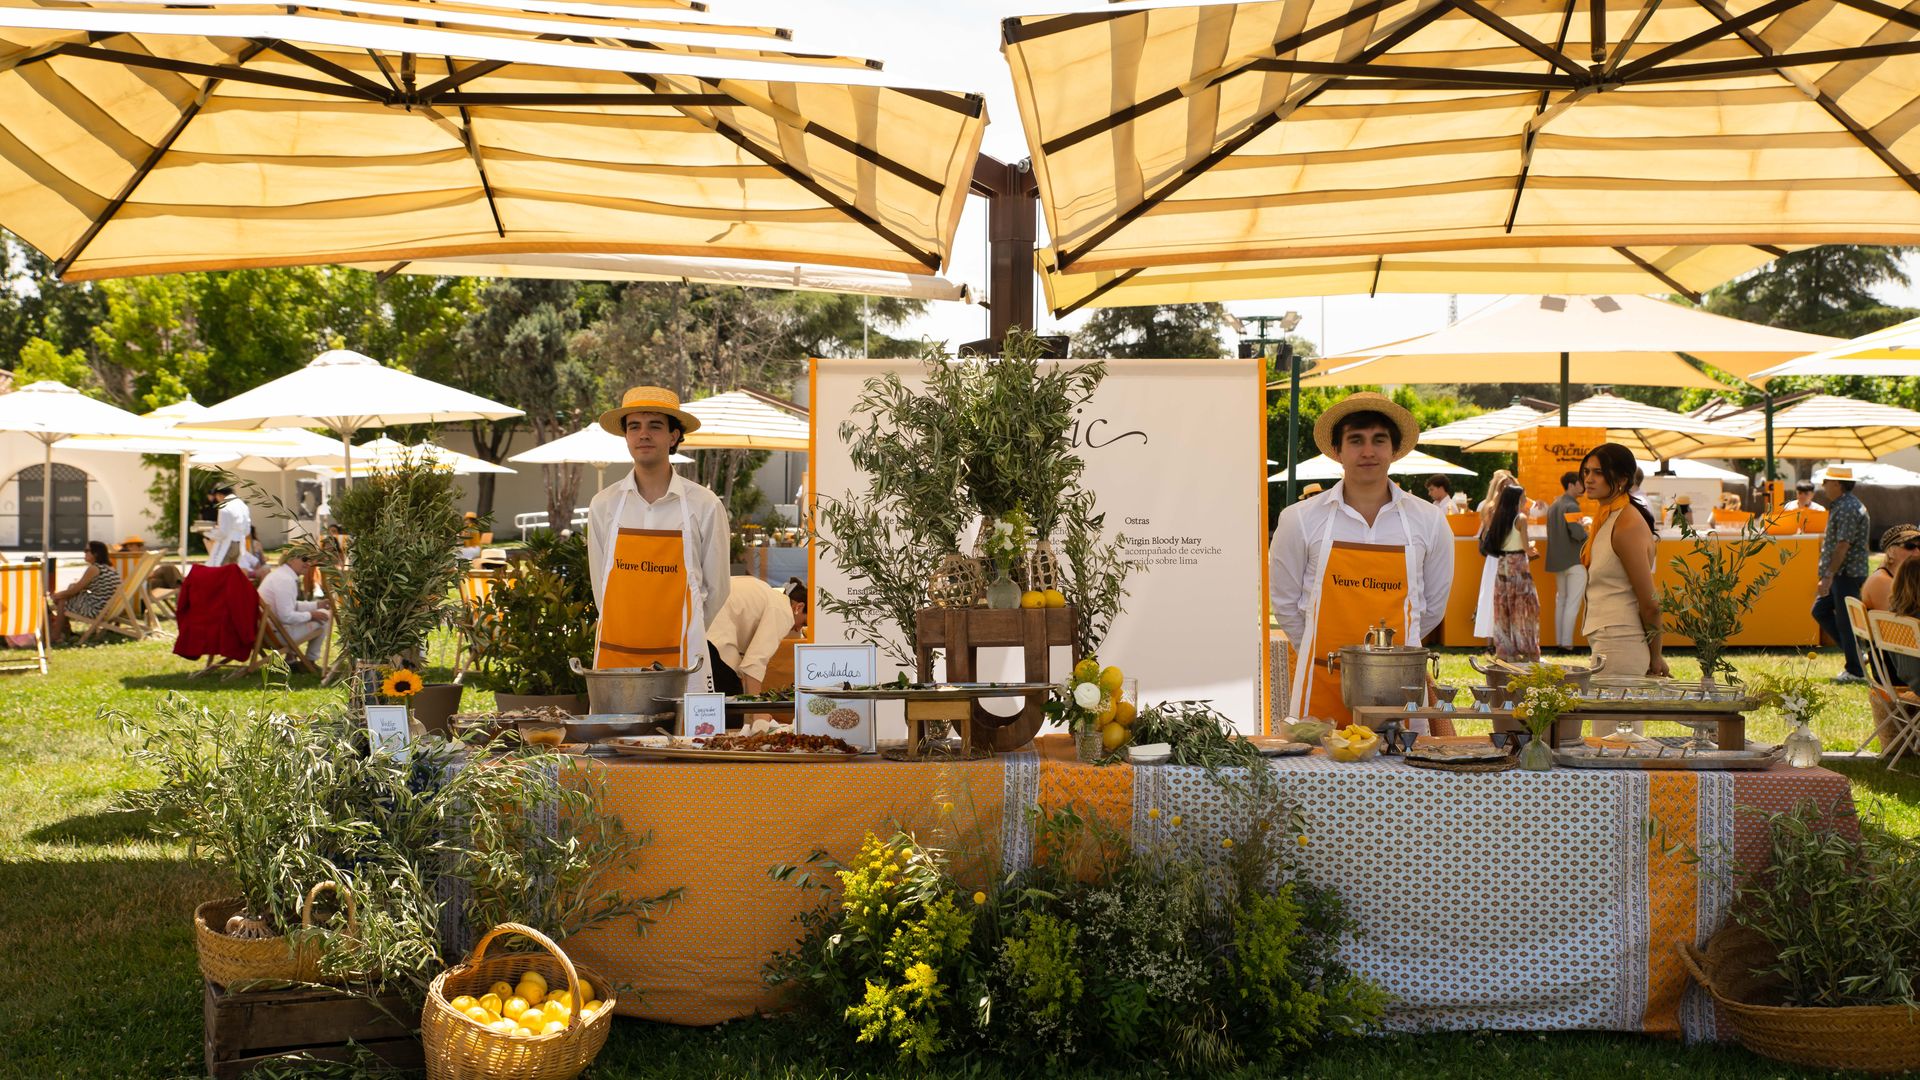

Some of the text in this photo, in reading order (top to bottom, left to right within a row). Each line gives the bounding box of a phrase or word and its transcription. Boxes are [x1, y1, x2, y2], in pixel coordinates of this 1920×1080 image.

[1125, 517, 1150, 525] Ostras
[1125, 536, 1201, 547] Virgin Bloody Mary
[1125, 546, 1222, 557] acompañado de ceviche
[1155, 557, 1178, 565] sobre
[1179, 556, 1198, 565] lima
[616, 559, 678, 574] Veuve Clicquot
[1332, 575, 1402, 592] Veuve Clicquot
[806, 662, 861, 680] Ensaladas
